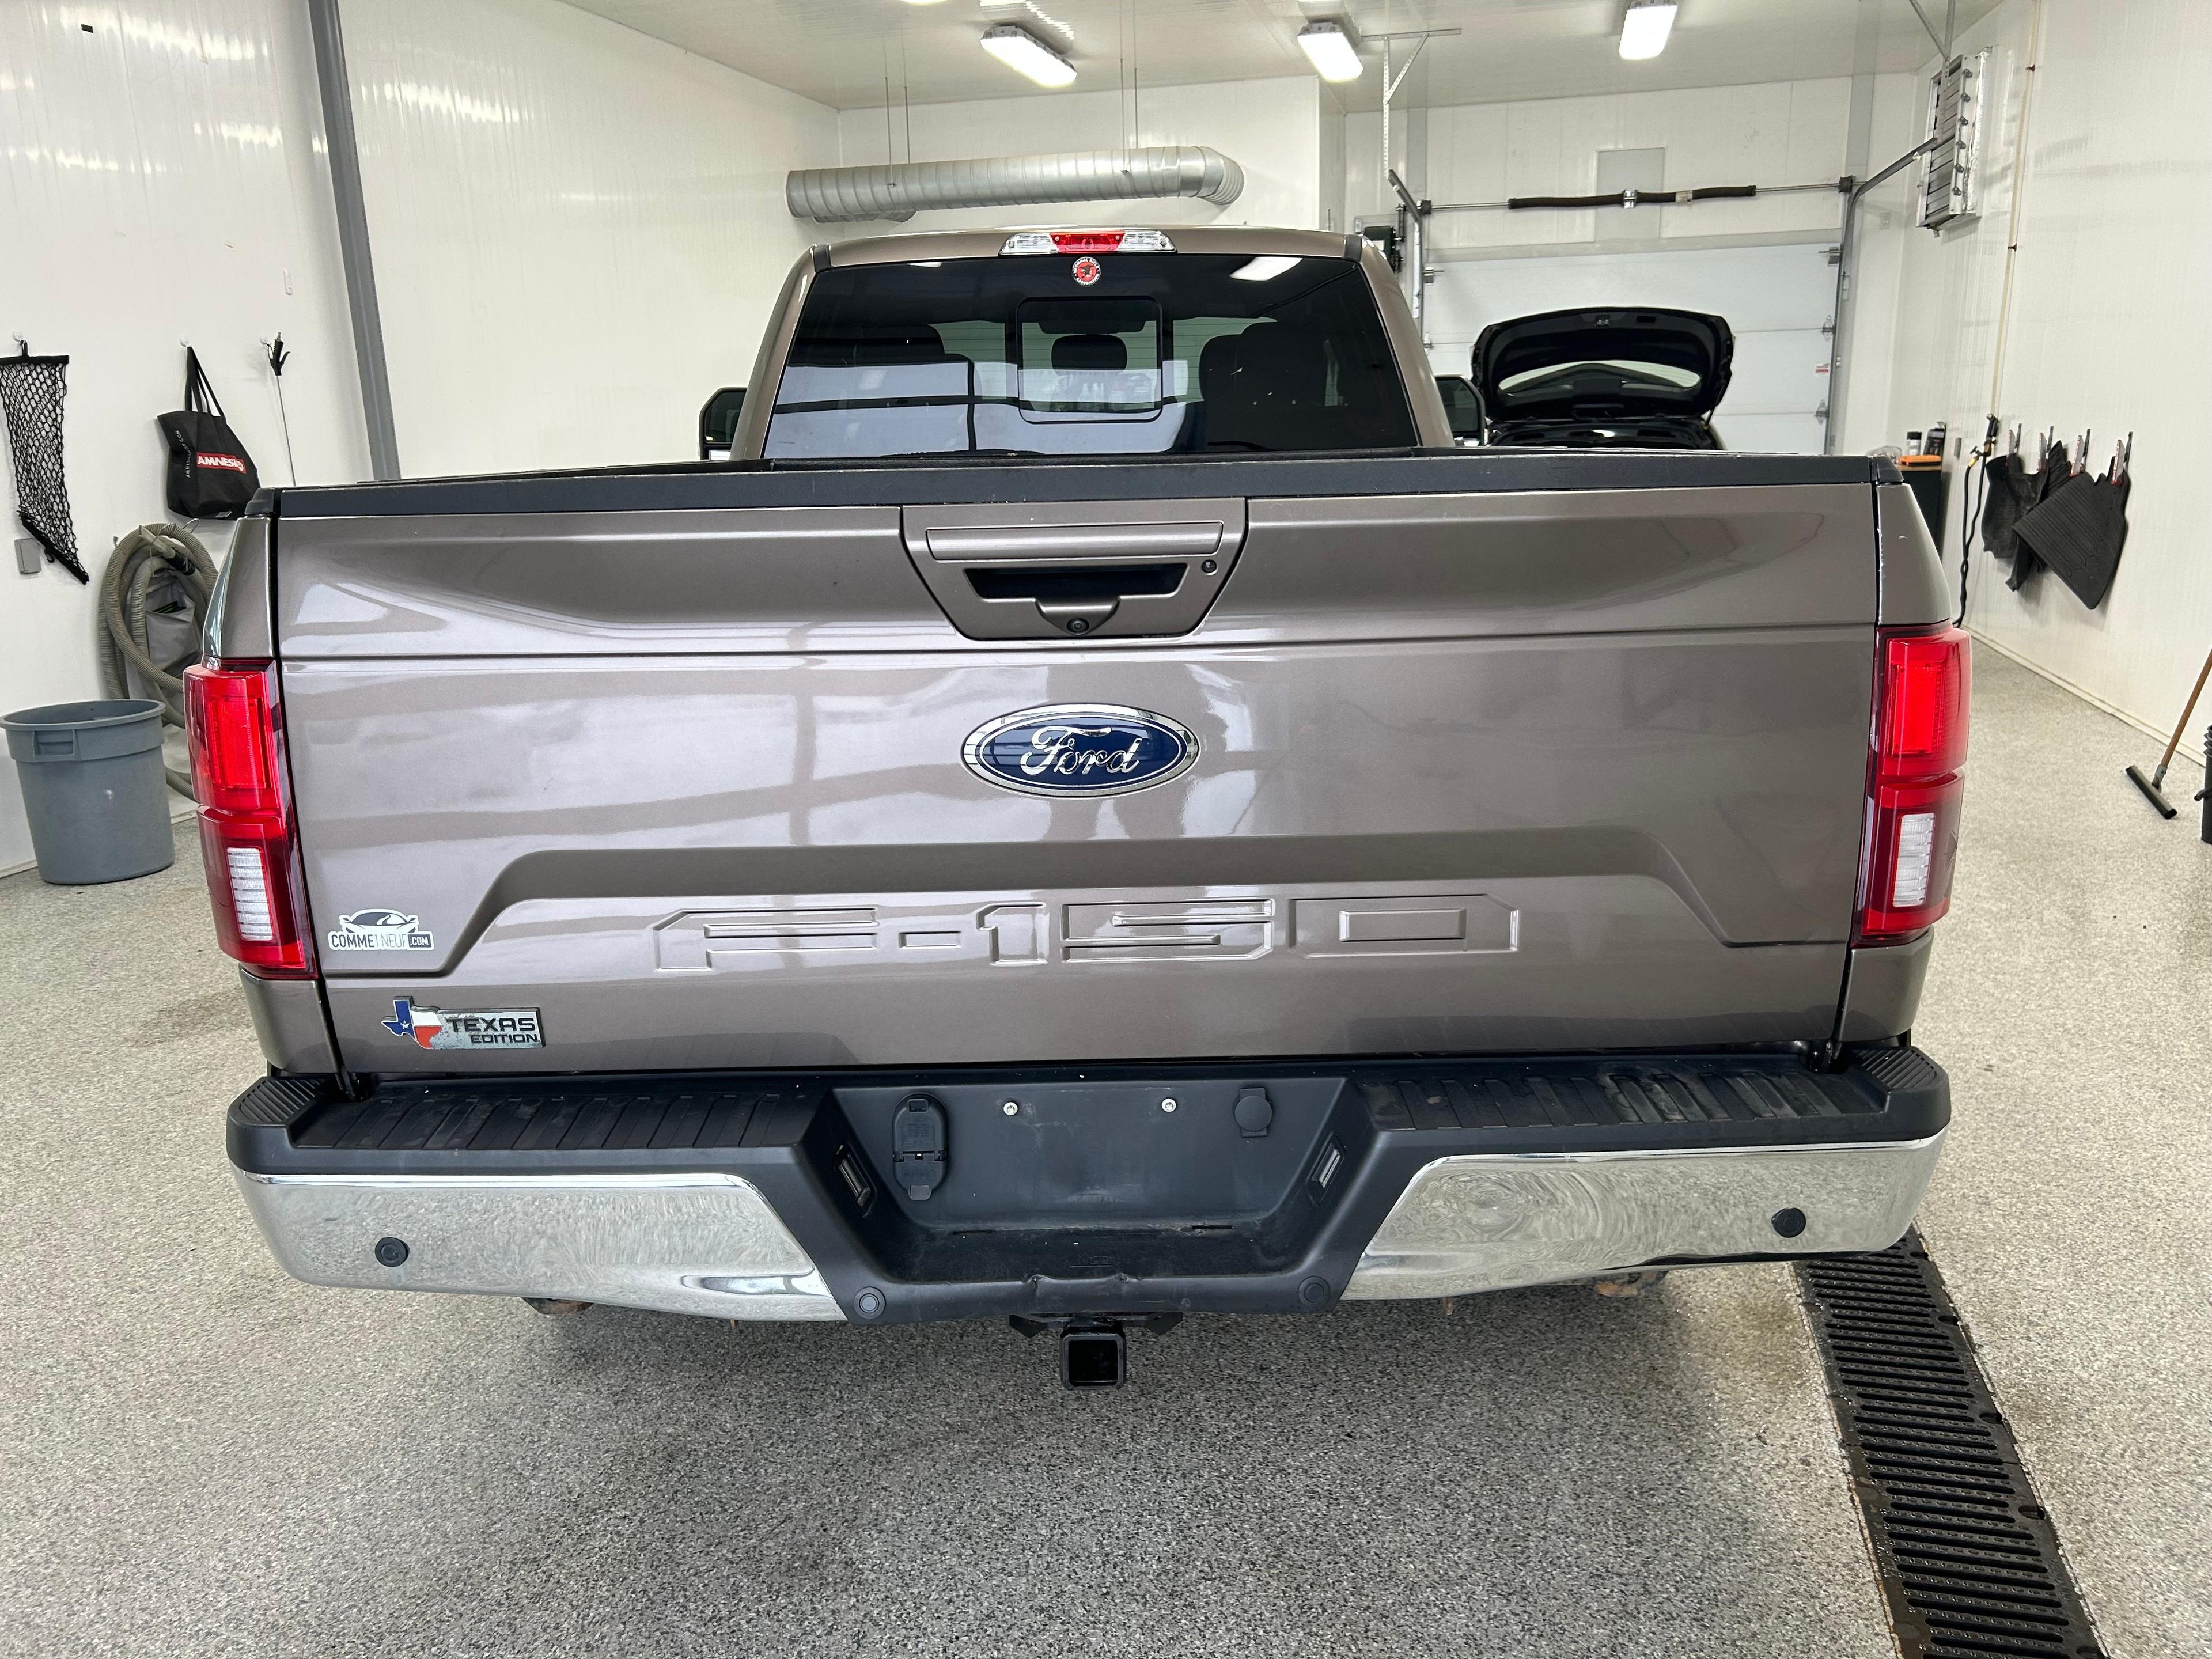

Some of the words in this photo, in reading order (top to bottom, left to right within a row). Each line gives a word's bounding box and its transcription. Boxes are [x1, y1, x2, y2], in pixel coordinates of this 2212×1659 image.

[1020, 725, 1142, 775] Ford
[652, 894, 1519, 972] F-150
[446, 1018, 535, 1032] TEXAS
[470, 1034, 538, 1043] EDITION
